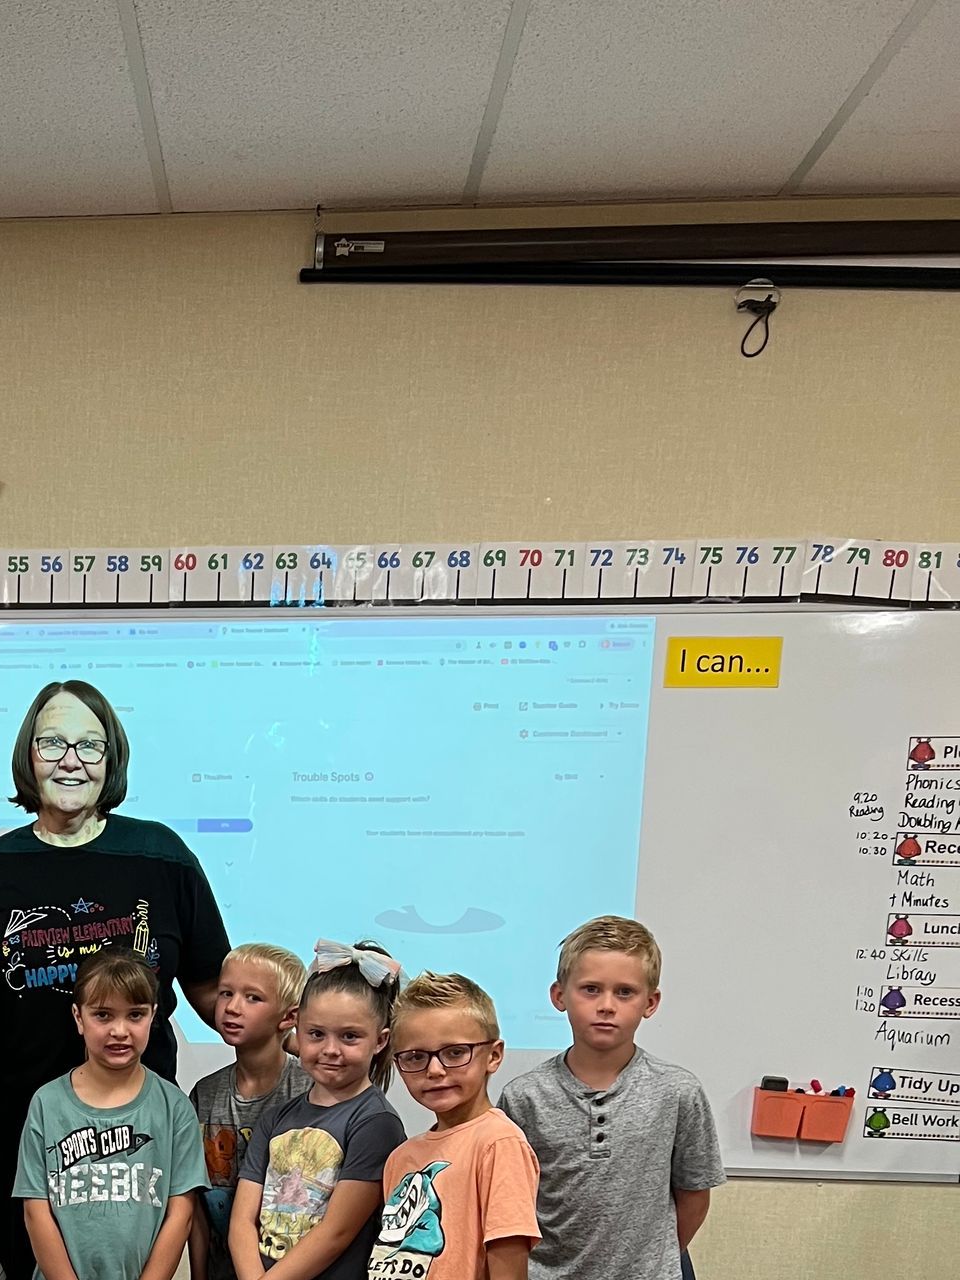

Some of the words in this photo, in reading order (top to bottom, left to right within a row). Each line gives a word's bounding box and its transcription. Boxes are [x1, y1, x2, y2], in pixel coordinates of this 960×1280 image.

[8, 556, 29, 572] 55
[41, 556, 62, 572] 56
[74, 556, 95, 572] 57
[107, 556, 128, 572] 58
[140, 555, 162, 572] 59
[175, 554, 196, 570] 60
[208, 554, 227, 570] 61
[243, 553, 264, 569] 62
[276, 553, 297, 569] 63
[310, 552, 332, 569] 64
[378, 552, 400, 568] 66
[412, 551, 435, 568] 67
[448, 551, 470, 567] 68
[484, 550, 506, 567] 69
[520, 550, 542, 566] 70
[555, 550, 574, 566] 71
[590, 549, 613, 566] 72
[627, 548, 649, 565] 73
[663, 548, 686, 564] 74
[700, 547, 723, 564] 75
[736, 547, 759, 564] 76
[773, 547, 796, 564] 77
[811, 544, 834, 561] 78
[847, 547, 870, 565] 79
[883, 550, 908, 567] 80
[919, 552, 942, 568] 81
[681, 650, 687, 673] I
[696, 651, 770, 674] can...
[292, 772, 328, 783] Trouble
[330, 772, 360, 784] Spots
[848, 805, 884, 822] Reading
[904, 792, 955, 814] Reading
[898, 812, 952, 833] Doubling
[897, 870, 935, 887] Math
[902, 892, 950, 908] Minutes
[20, 926, 70, 948] FAIRVIEW
[72, 915, 135, 942] ELEMENTARY
[57, 945, 74, 958] is
[24, 963, 78, 988] HAPPY
[886, 964, 936, 986] Library
[874, 1020, 951, 1051] Aquarium
[899, 1076, 932, 1093] Tidy
[938, 1080, 960, 1094] Up
[892, 1114, 918, 1126] Bell
[922, 1114, 959, 1127] Work
[61, 1128, 97, 1166] SPORTS
[100, 1126, 130, 1156] CLUB
[399, 1258, 425, 1278] DO
